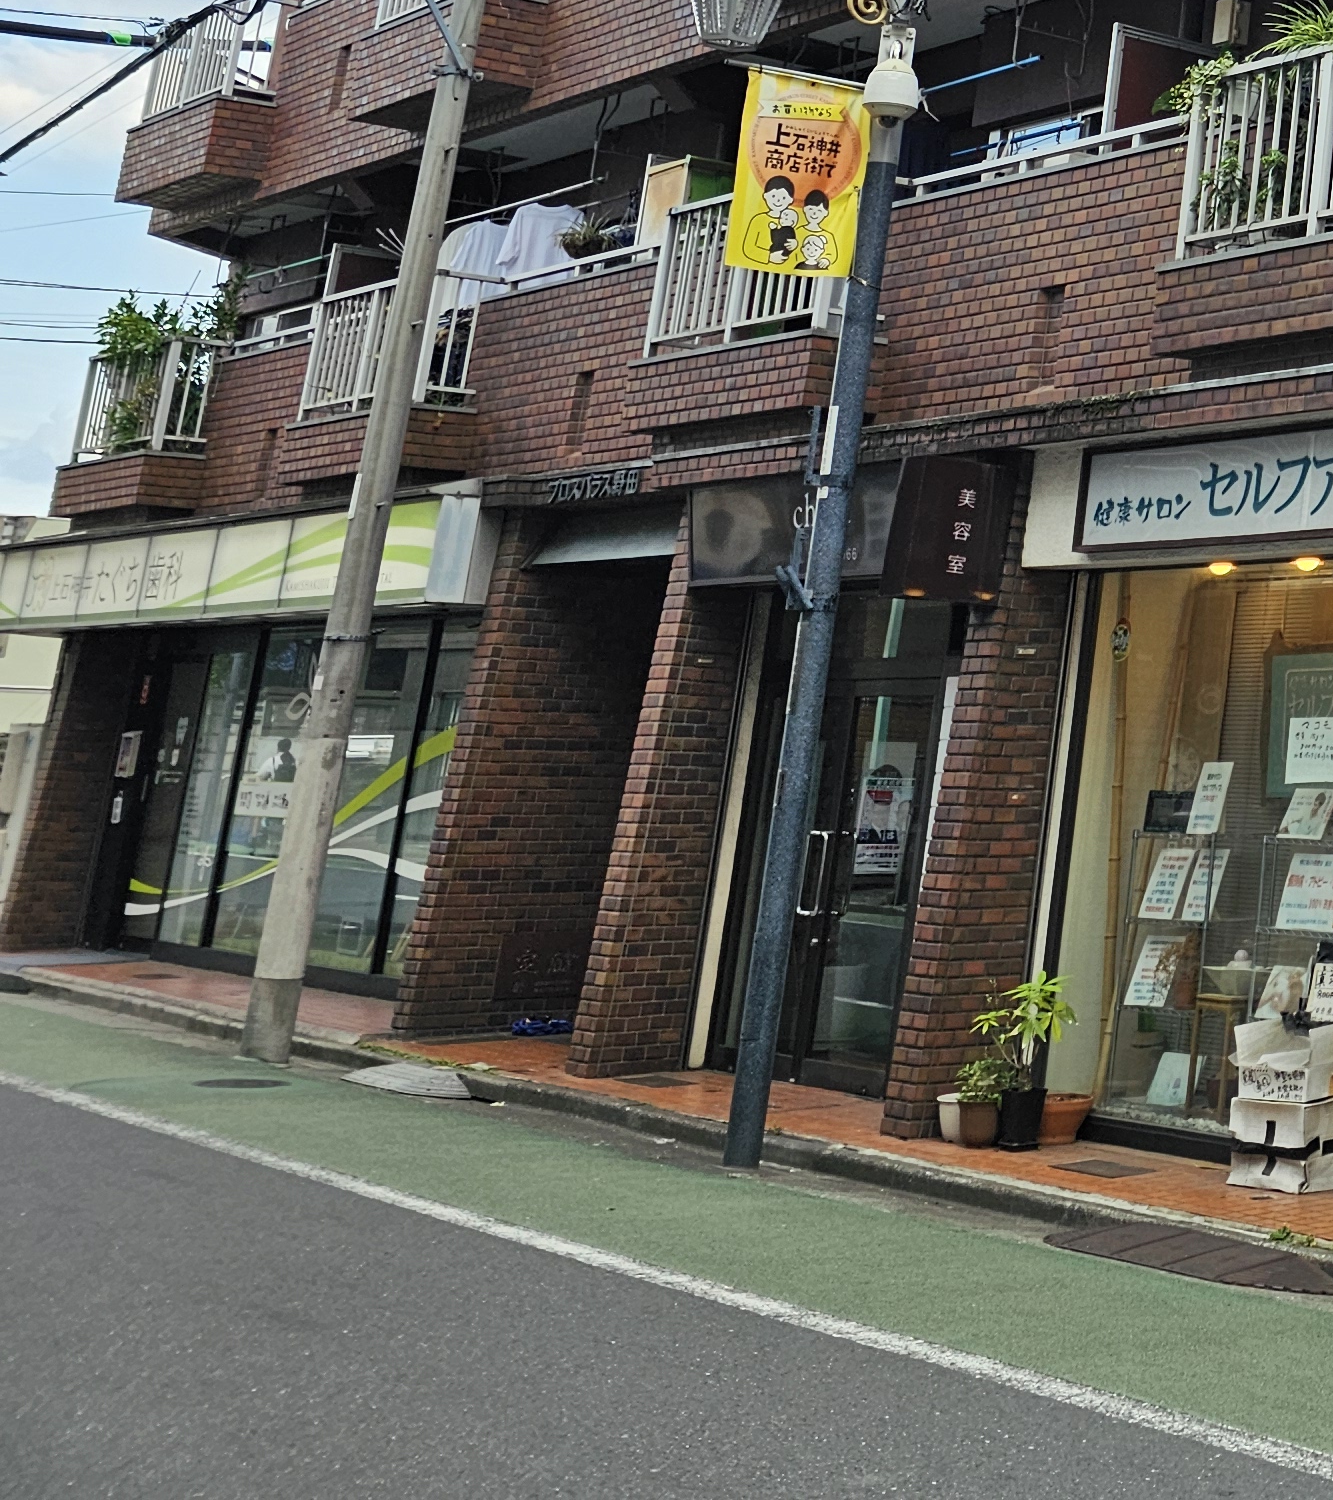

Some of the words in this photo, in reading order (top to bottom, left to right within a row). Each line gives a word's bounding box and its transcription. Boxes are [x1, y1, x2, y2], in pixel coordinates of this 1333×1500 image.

[765, 123, 841, 158] 上石神井
[765, 149, 837, 178] 商店街で
[1093, 493, 1192, 527] 健康サロン
[945, 488, 977, 575] 美容室
[92, 550, 184, 604] たぐち歯科
